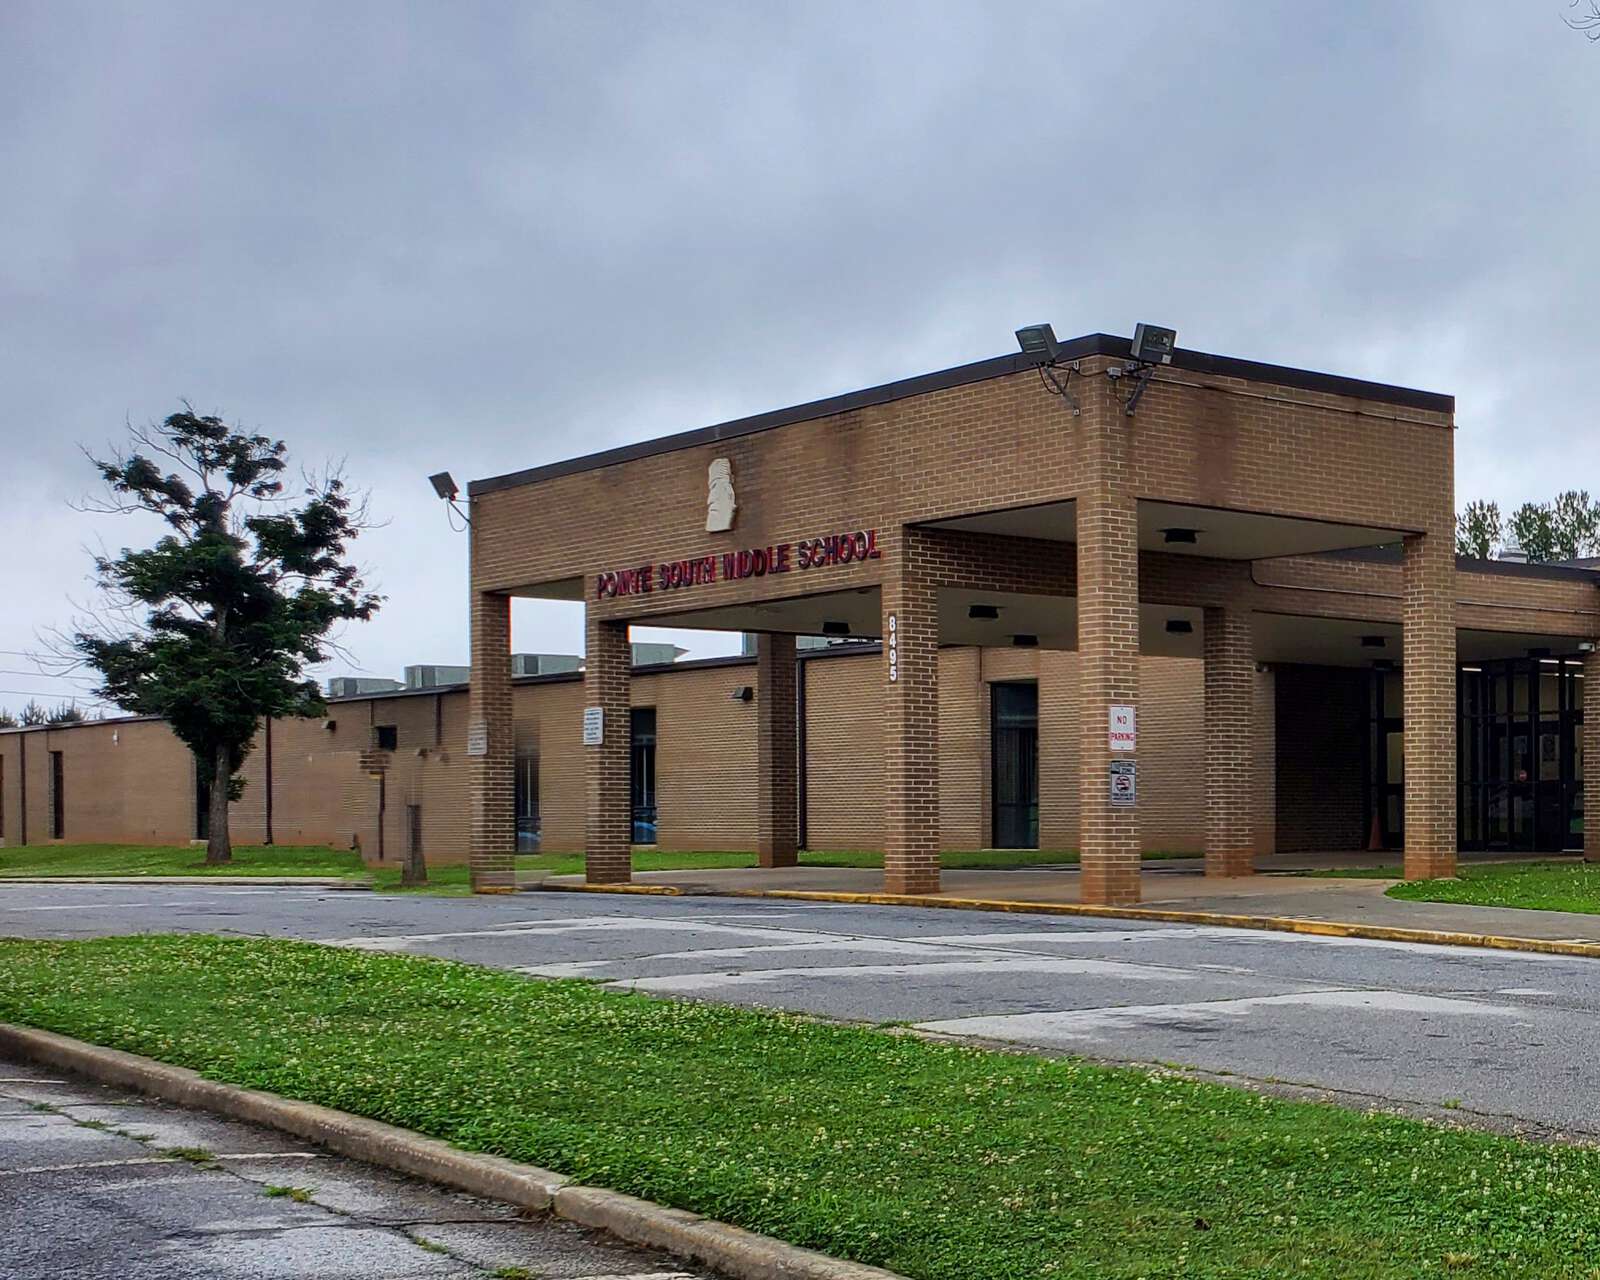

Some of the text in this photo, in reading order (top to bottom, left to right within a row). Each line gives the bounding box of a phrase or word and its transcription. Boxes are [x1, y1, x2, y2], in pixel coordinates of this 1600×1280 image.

[597, 530, 881, 599] POINTE SOUTH MIDDLE SCHOOL
[889, 616, 897, 681] 8495
[1111, 732, 1134, 742] PARKING
[1116, 715, 1128, 725] NO
